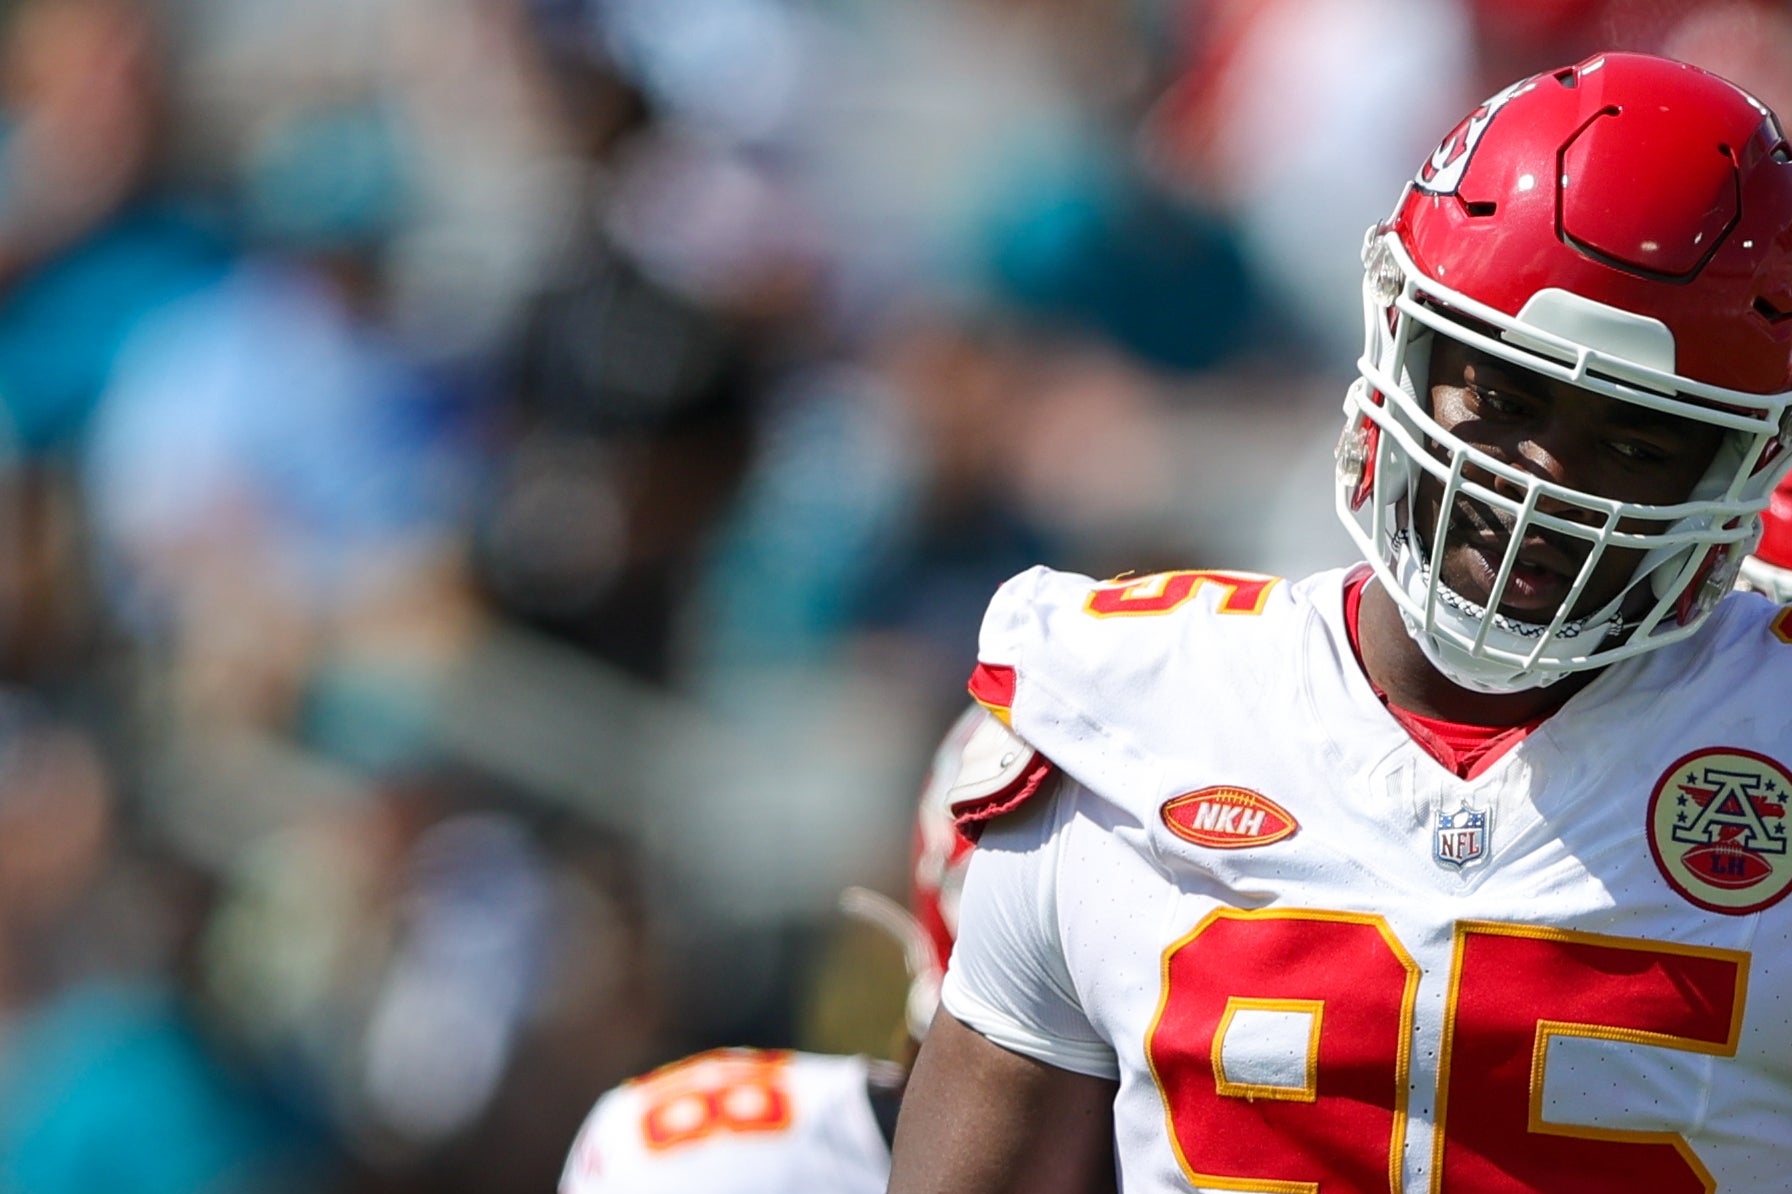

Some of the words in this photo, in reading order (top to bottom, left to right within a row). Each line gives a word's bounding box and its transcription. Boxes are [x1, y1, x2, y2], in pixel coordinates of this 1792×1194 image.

[1193, 802, 1266, 836] NKH
[1671, 768, 1787, 855] A
[1441, 831, 1480, 859] NFL
[1711, 854, 1745, 876] LH
